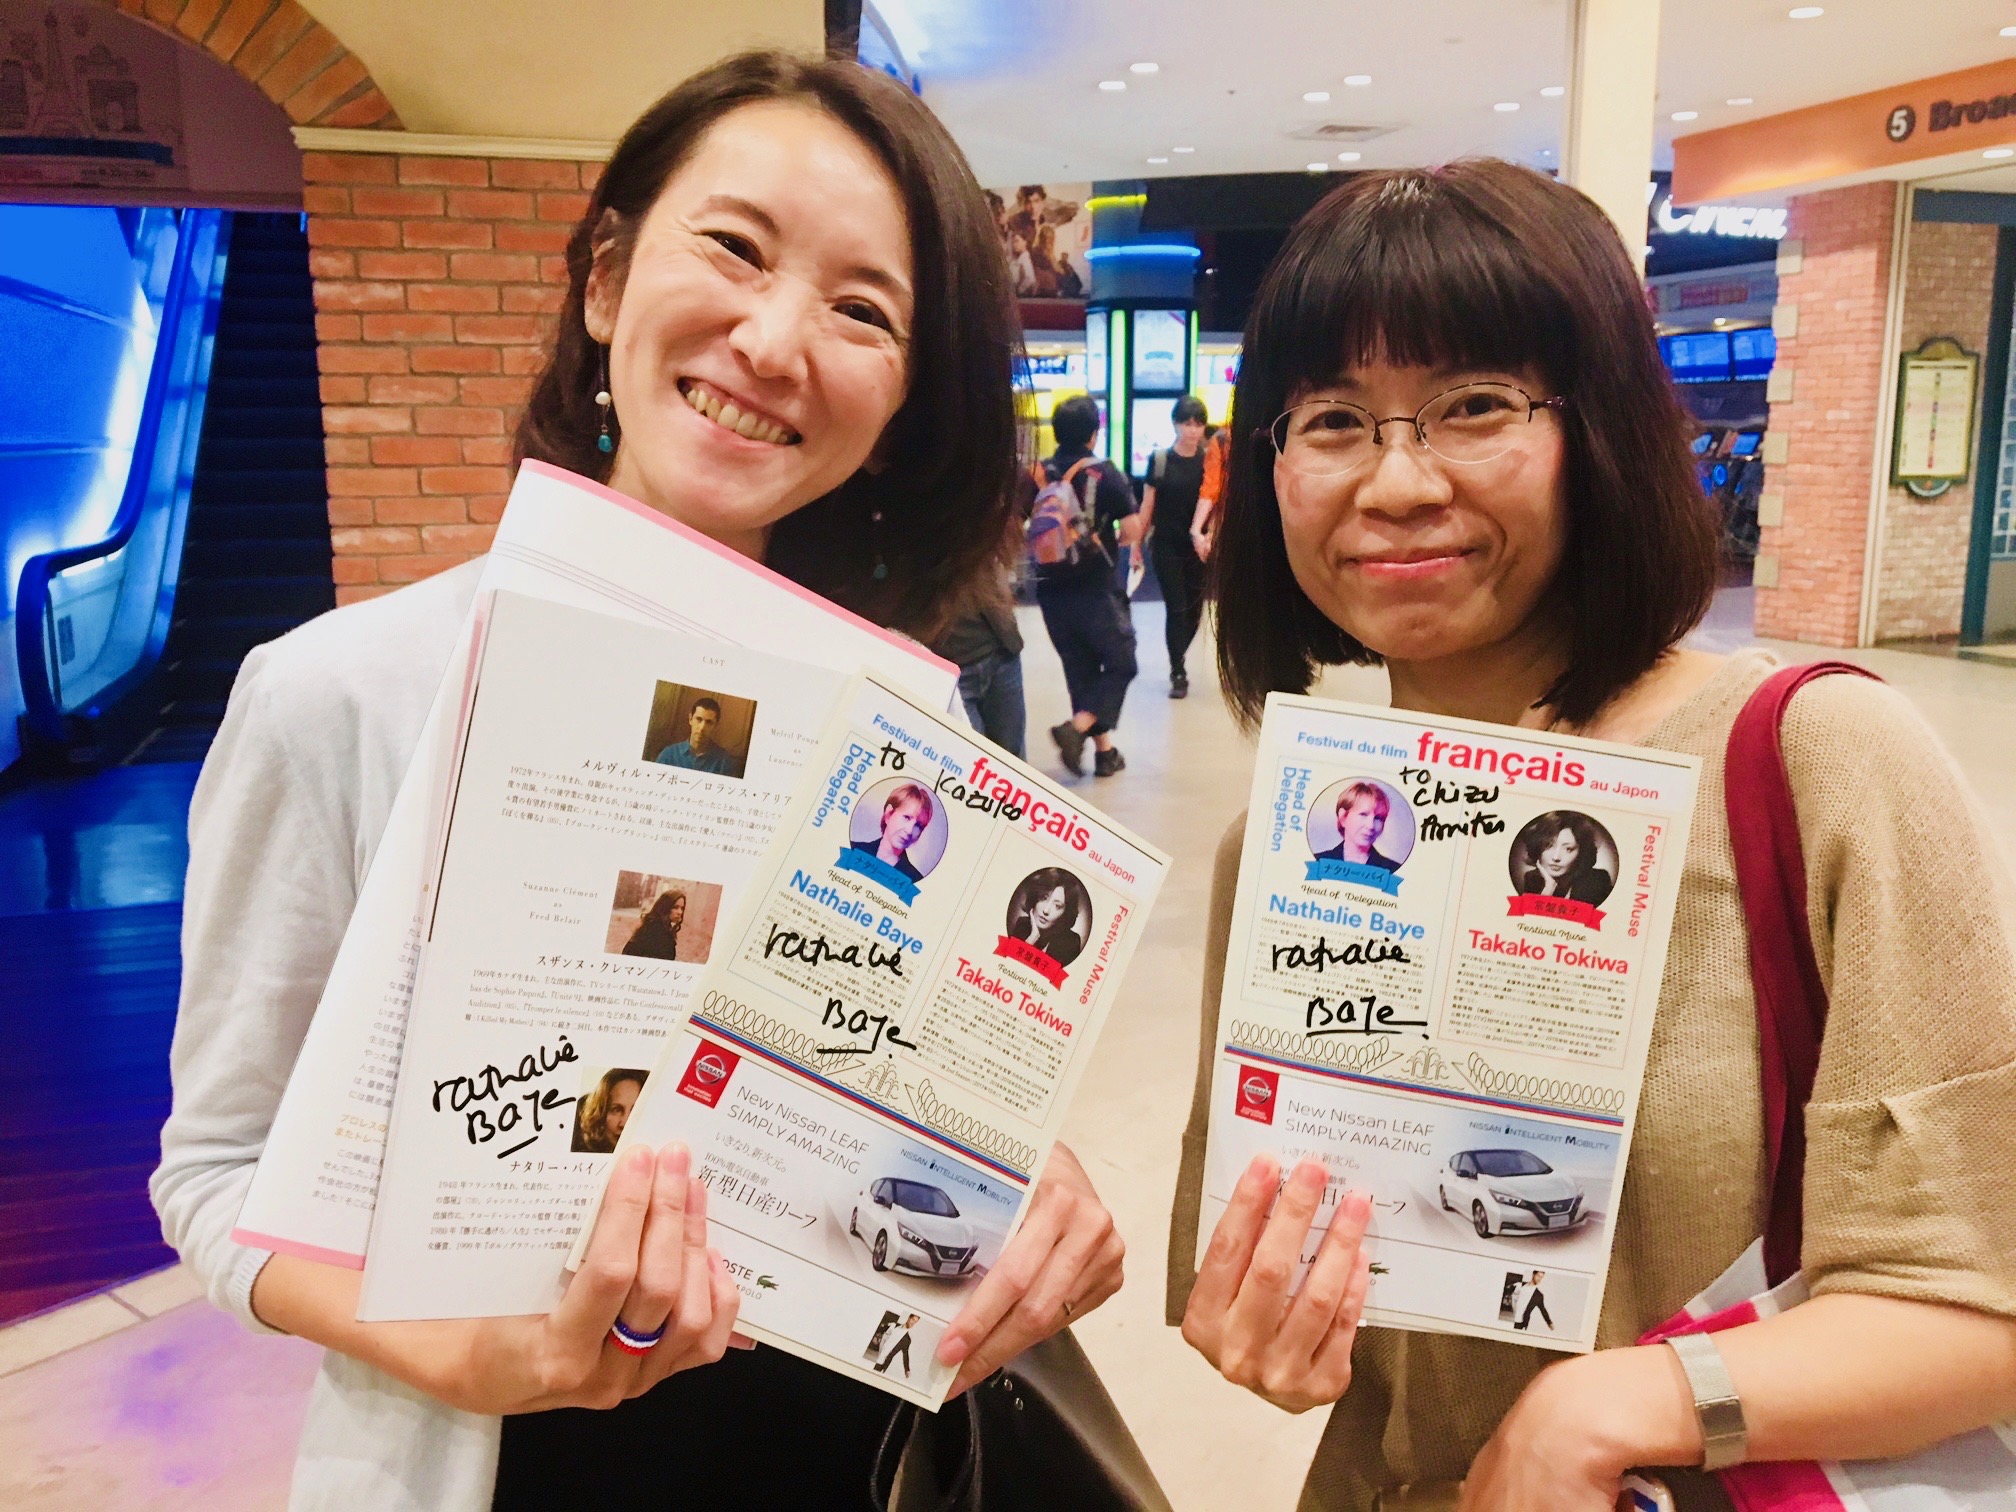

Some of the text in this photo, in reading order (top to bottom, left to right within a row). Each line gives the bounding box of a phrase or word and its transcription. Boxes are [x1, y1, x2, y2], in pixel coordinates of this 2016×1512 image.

[1891, 109, 1907, 138] 5
[1658, 195, 1787, 239] CINEM
[811, 743, 864, 829] Delegation
[837, 750, 876, 816] Head of
[1297, 731, 1659, 800] Festival du film français au Japon
[872, 713, 1136, 884] Festival du film français au Japon
[1271, 766, 1297, 852] Delegation
[1289, 768, 1312, 832] Head of
[827, 870, 908, 920] Head of Delegation
[1301, 884, 1398, 909] Head of Delegation
[1627, 824, 1662, 939] Festival Muse
[789, 869, 923, 955] Nathalie Baye
[1269, 893, 1425, 941] Nathalie Baye
[1517, 922, 1587, 942] Festival Muse
[1079, 905, 1129, 1005] Festival Muse
[1468, 929, 1629, 974] Takako Tokiwa
[955, 957, 1014, 1004] Takako
[1018, 991, 1073, 1038] Tokiwa
[997, 963, 1048, 998] Festival Muse
[698, 1062, 723, 1077] NISSAN
[727, 1104, 861, 1175] SIMPLY AMAZING
[736, 1086, 870, 1154] New Nissan LEAF
[1285, 1118, 1431, 1156] SIMPLY AMAZING
[1288, 1100, 1326, 1119] New
[1330, 1108, 1387, 1130] Nissan
[1392, 1119, 1435, 1137] LEAF
[1468, 1120, 1501, 1132] NISSAN
[704, 1152, 770, 1187] 100%電気自動車
[899, 1147, 928, 1166] NISSAN
[698, 1165, 817, 1229] 新型日産リーフ
